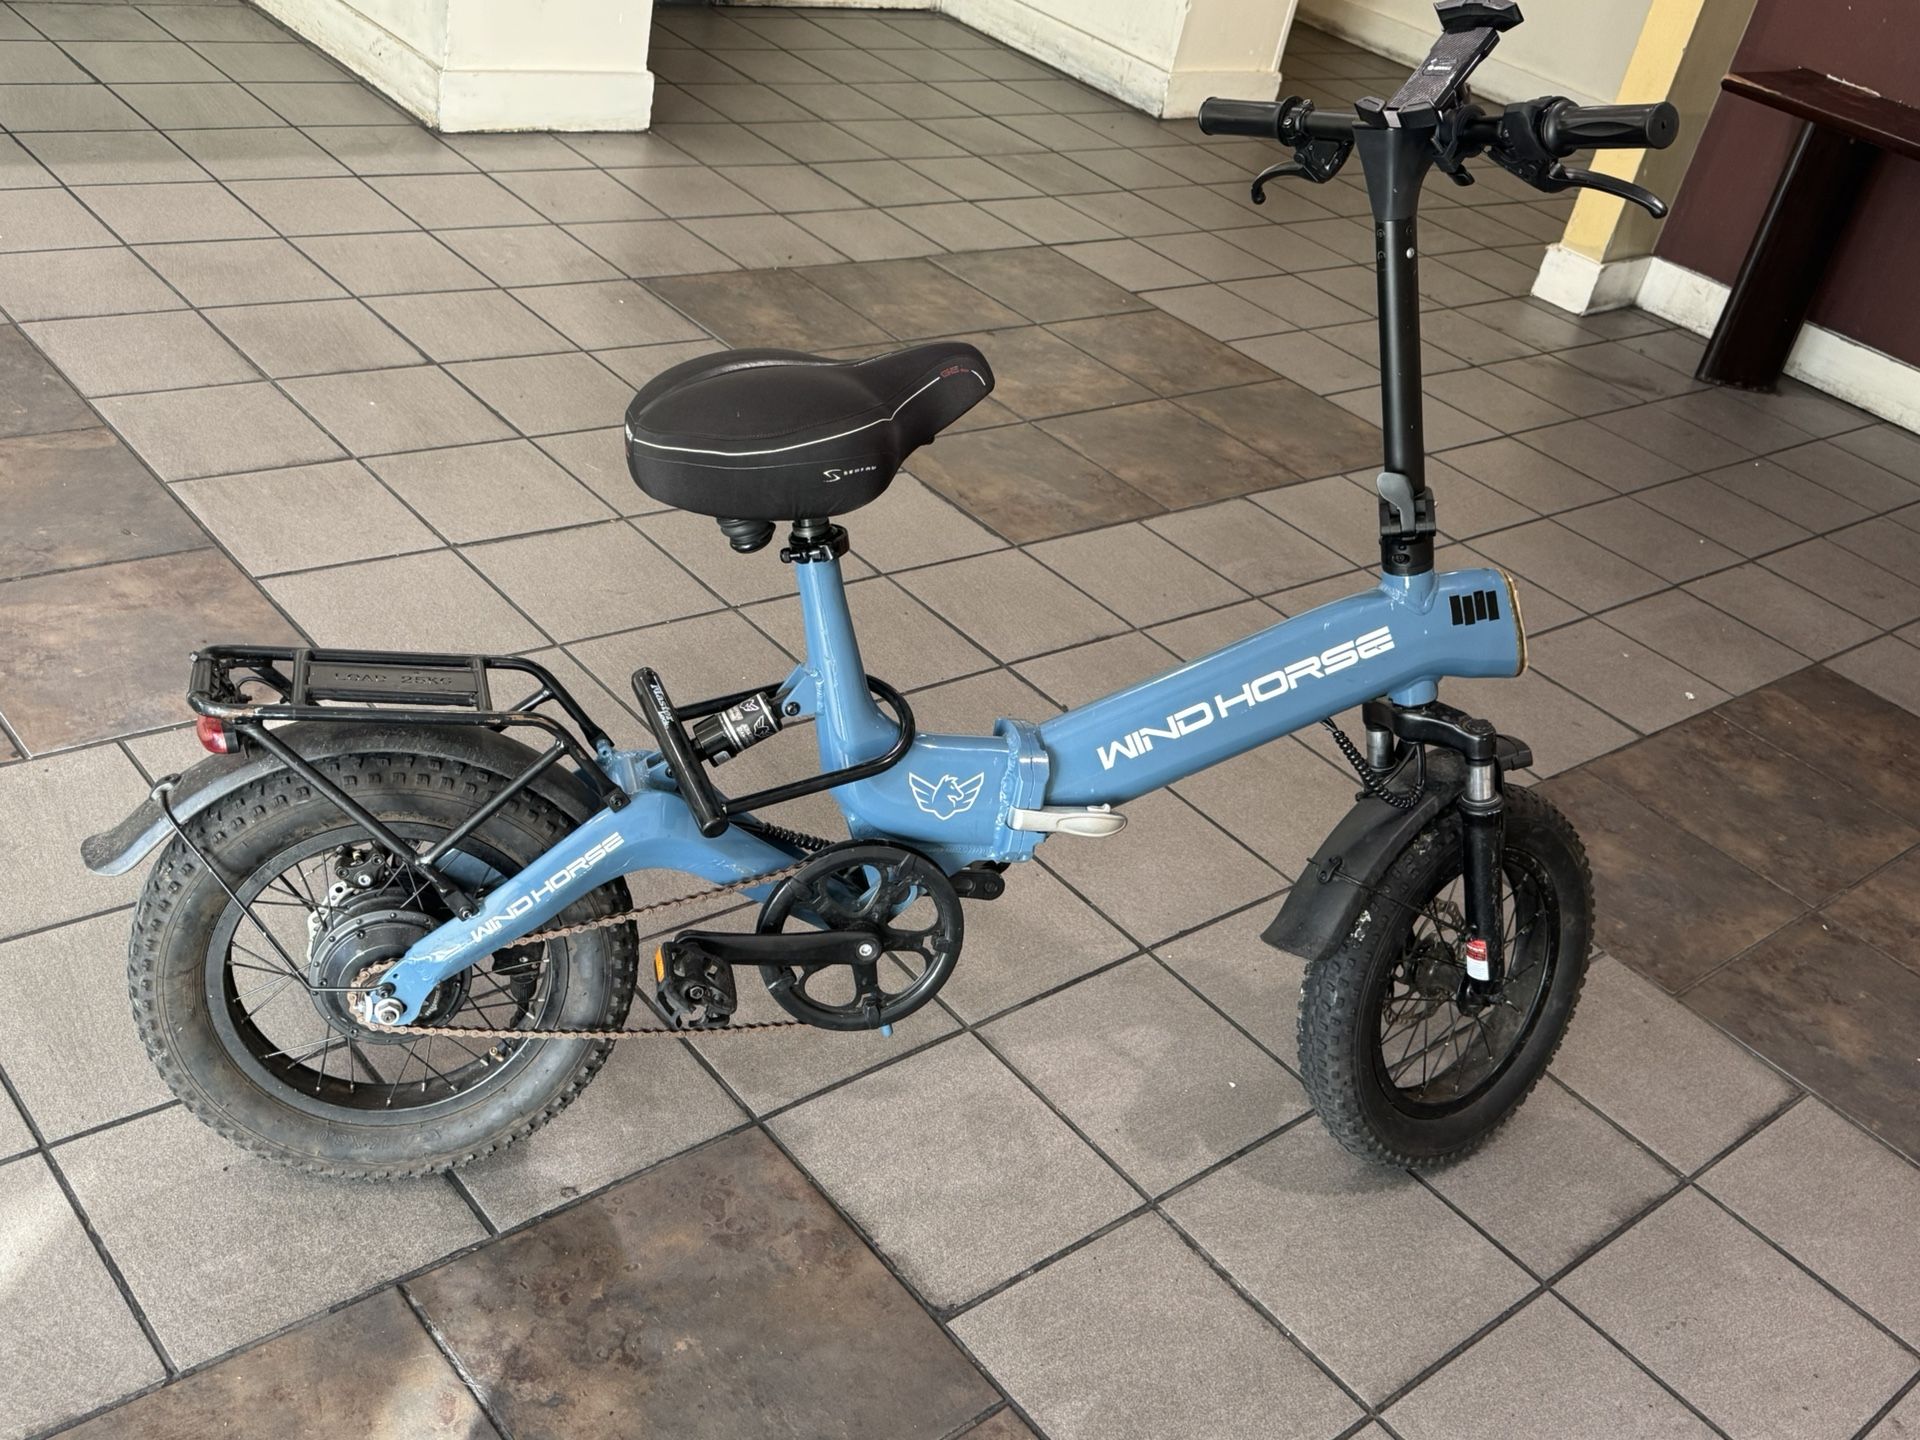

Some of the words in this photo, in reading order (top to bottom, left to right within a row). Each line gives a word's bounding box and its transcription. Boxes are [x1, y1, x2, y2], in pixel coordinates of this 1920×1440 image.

[335, 672, 387, 683] LOAD
[400, 675, 452, 686] 25KG
[650, 684, 674, 722] Master
[1096, 701, 1214, 770] WIND
[1214, 625, 1396, 719] HORSE
[471, 895, 533, 943] WIND
[530, 831, 624, 903] HORSE
